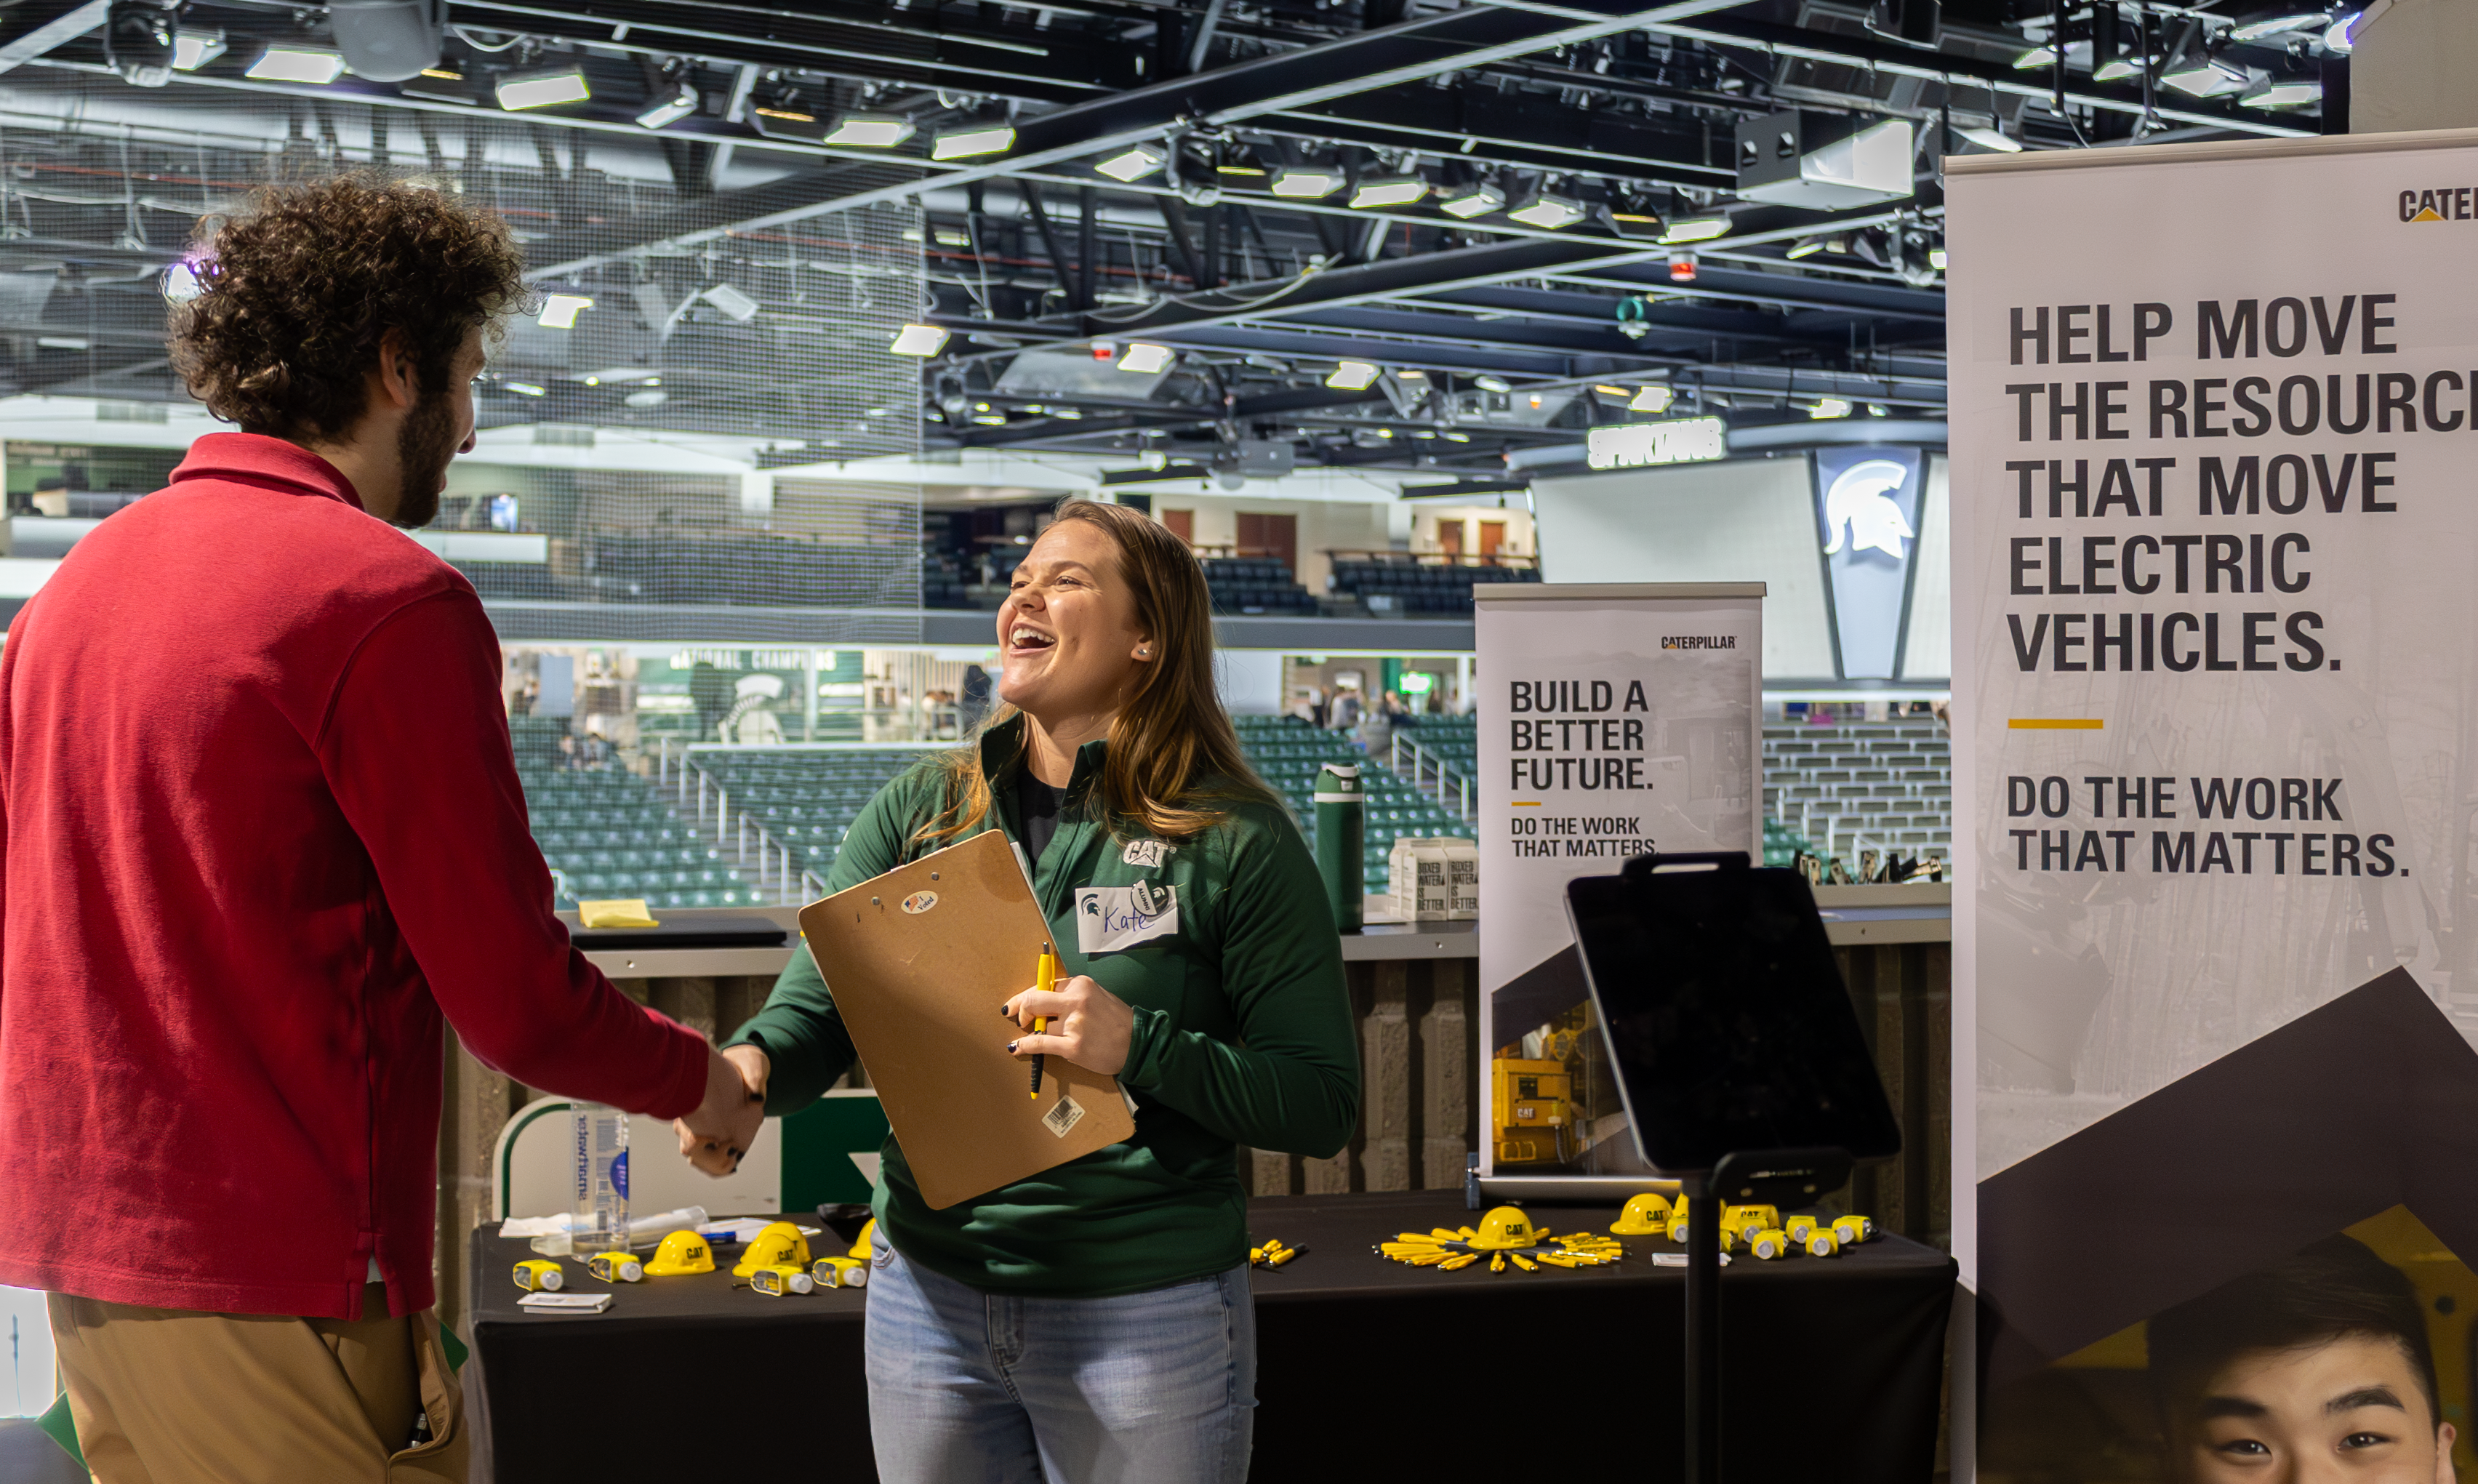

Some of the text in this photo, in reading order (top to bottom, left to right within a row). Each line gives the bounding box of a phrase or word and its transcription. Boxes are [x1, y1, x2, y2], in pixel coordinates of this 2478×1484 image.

[2010, 293, 2397, 365] HELP MOVE
[2005, 370, 2478, 442] THE RESOURC
[2005, 452, 2397, 518] THAT MOVE
[2010, 532, 2311, 595] ELECTRIC
[1661, 635, 1737, 649] CATERPILLAR
[2006, 611, 2341, 672] VEHICLES.
[1510, 681, 1649, 713] BUILD A
[1511, 719, 1644, 751] BETTER
[1511, 758, 1653, 790] FUTURE.
[2007, 776, 2343, 821] DO THE WORK
[1511, 817, 1640, 835] DO THE WORK
[1512, 839, 1561, 857] THAT
[2008, 829, 2409, 877] THAT MATTERS.
[918, 896, 934, 910] Voted
[1138, 888, 1150, 910] ALUMNI
[1104, 906, 1155, 934] Kate
[1517, 1108, 1534, 1119] CAT
[1506, 1224, 1523, 1235] CAT
[1646, 1210, 1664, 1221] CAT
[686, 1246, 703, 1259] CAT
[777, 1248, 794, 1261] CAT
